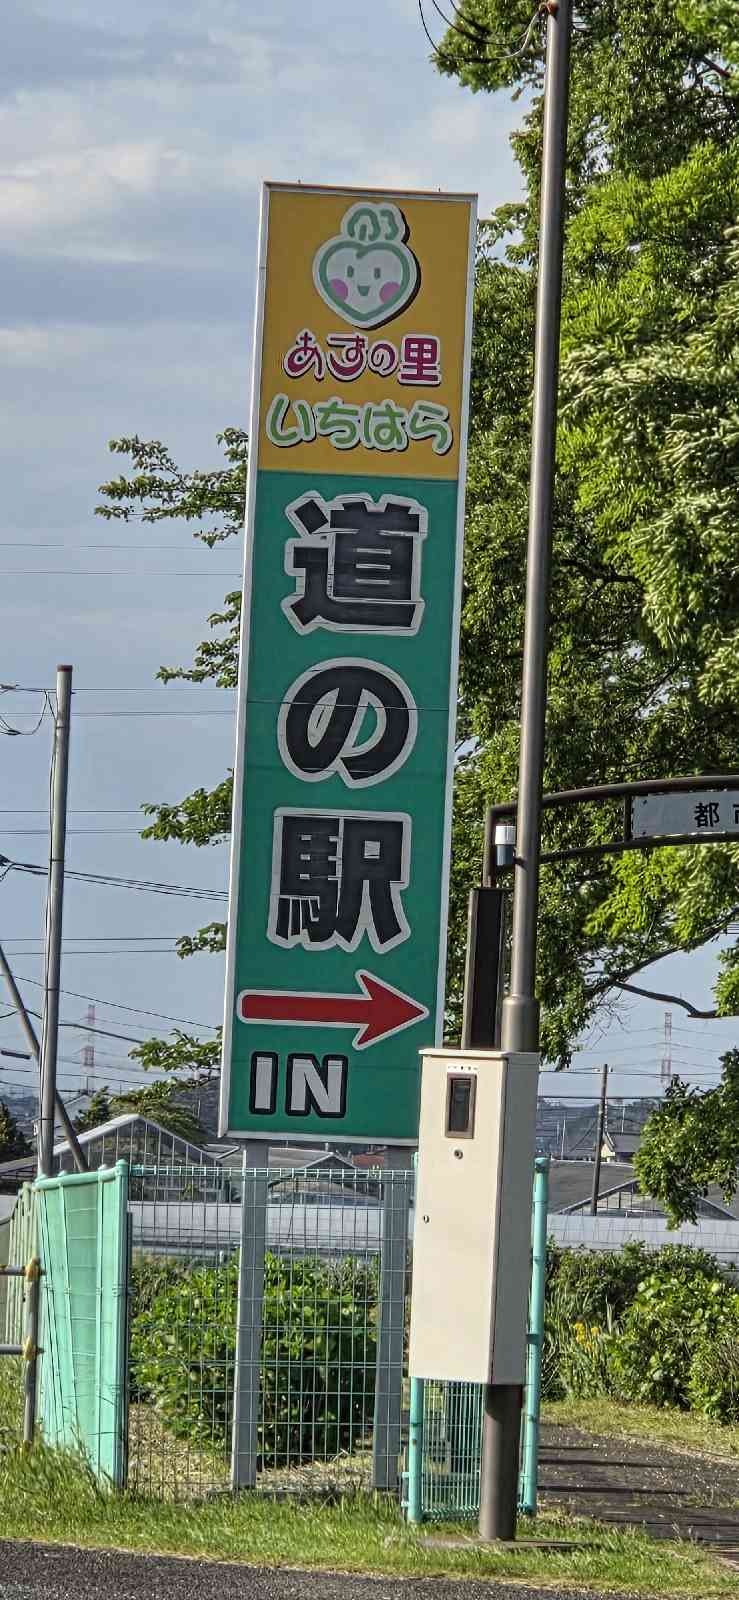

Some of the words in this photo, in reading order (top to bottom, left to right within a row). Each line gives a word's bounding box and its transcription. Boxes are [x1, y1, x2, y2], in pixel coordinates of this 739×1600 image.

[285, 332, 441, 383] あずの里
[268, 398, 452, 453] いちはら
[273, 495, 426, 946] 道の駅
[694, 802, 739, 827] 都
[251, 1052, 347, 1117] IN
